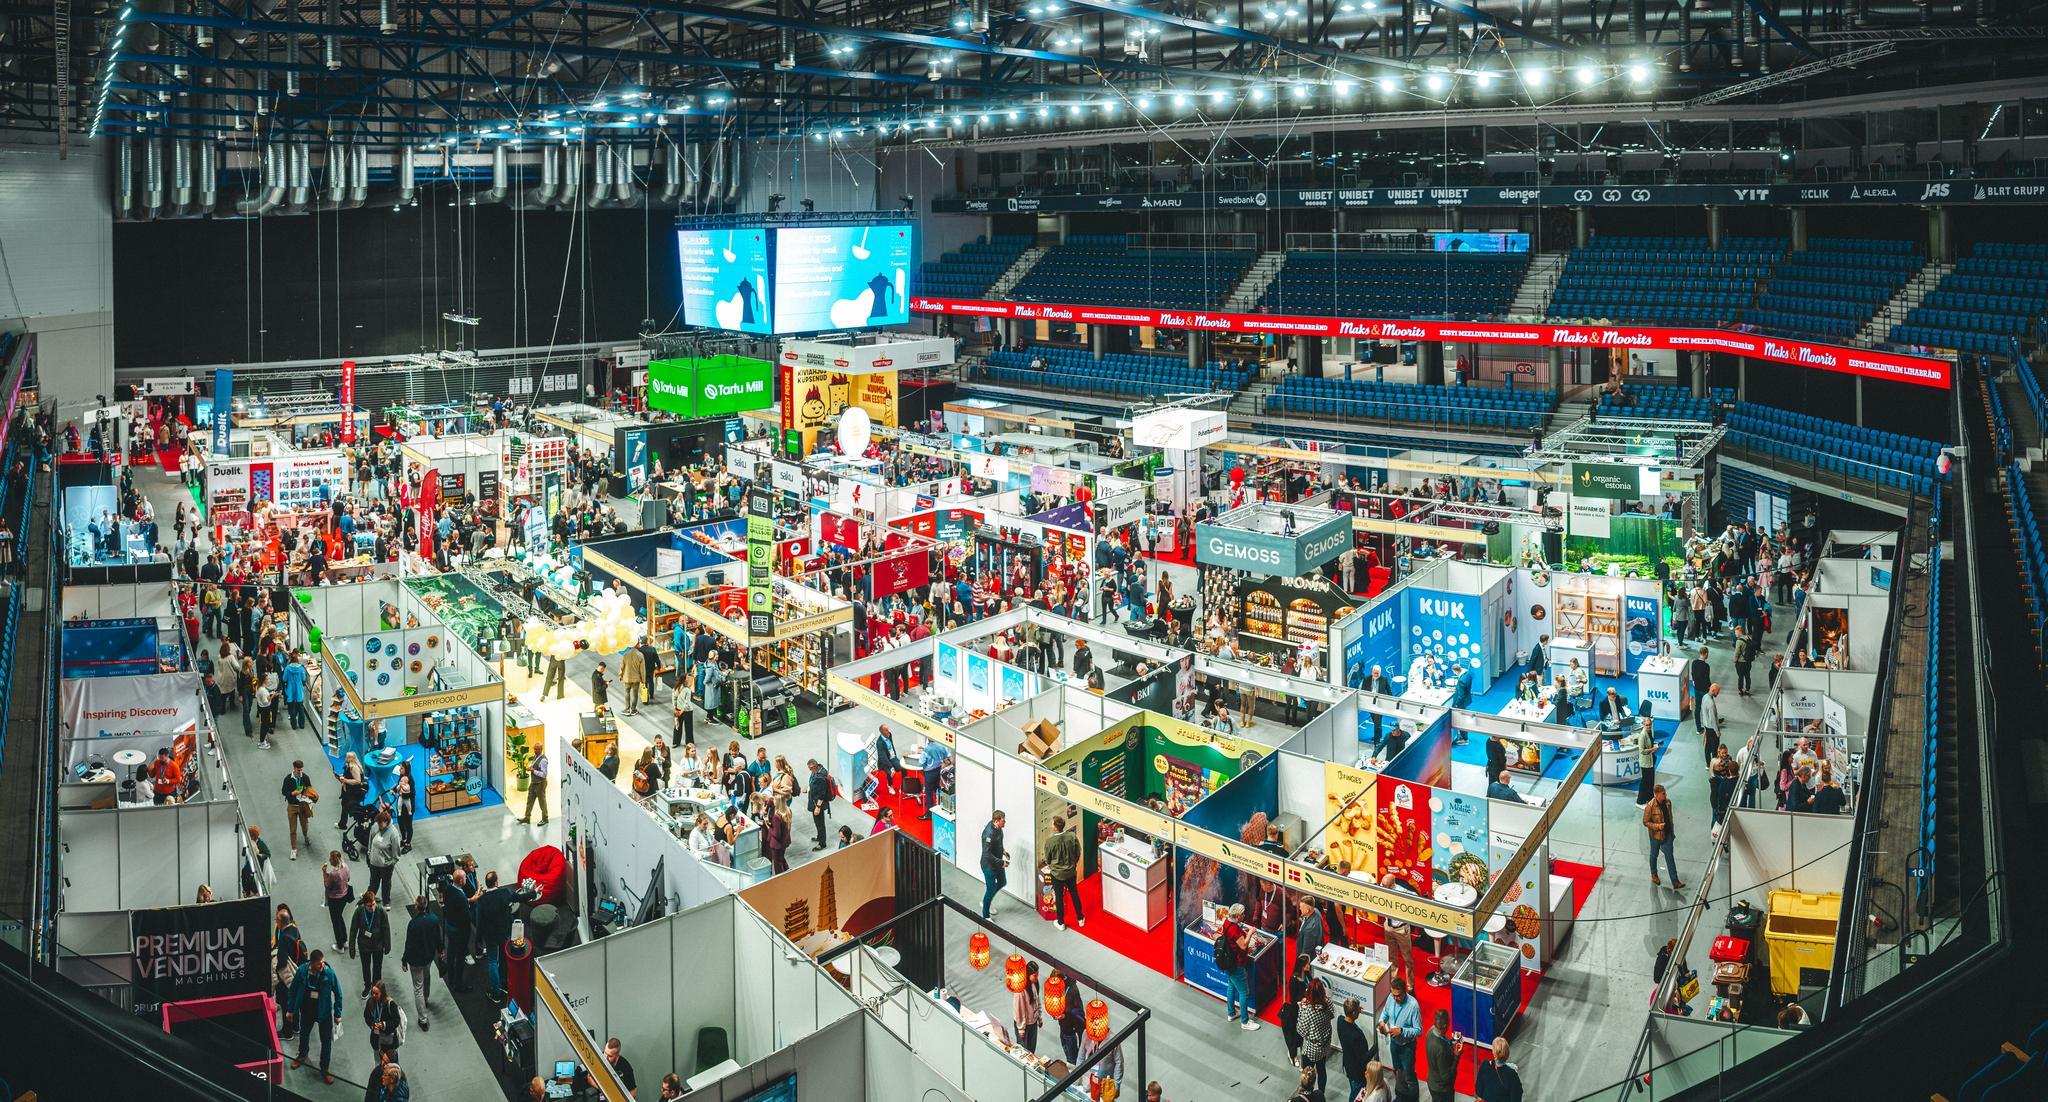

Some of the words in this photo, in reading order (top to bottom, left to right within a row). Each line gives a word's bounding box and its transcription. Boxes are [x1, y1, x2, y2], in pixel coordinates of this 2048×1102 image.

[1299, 191, 1333, 200] UNIBET
[1339, 190, 1374, 199] UNIBET
[1388, 190, 1424, 199] UNIBET
[1431, 189, 1468, 198] UNIBET
[1500, 190, 1540, 204] elenger
[1734, 189, 1769, 200] YIT
[1863, 189, 1897, 197] ALEXELA
[1920, 183, 1950, 200] JAS
[1987, 187, 2011, 196] BLRT
[2013, 186, 2046, 195] GRUPP
[970, 201, 988, 209] weber
[1153, 199, 1182, 207] MARU
[1219, 196, 1255, 204] Swedbank
[920, 300, 943, 311] Moorits
[1015, 305, 1035, 316] Maks
[1036, 308, 1041, 316] &
[1043, 307, 1073, 319] Moorits
[1160, 314, 1185, 326] Maks
[1186, 316, 1193, 326] &
[1194, 316, 1231, 329] Moorits
[1340, 322, 1369, 335] Maks
[1371, 325, 1380, 335] &
[1382, 323, 1425, 338] Moorits
[1553, 329, 1588, 344] Maks
[1589, 332, 1600, 343] &
[1601, 330, 1652, 345] Moorits
[1764, 341, 1789, 359] Maks
[1790, 347, 1797, 360] &
[1799, 346, 1836, 367] Moorits
[660, 380, 675, 396] Tartu
[676, 385, 688, 398] Mill
[717, 384, 745, 396] Tartu
[746, 380, 764, 393] Mill
[1593, 475, 1621, 484] organic
[1605, 482, 1632, 490] estonia
[1210, 537, 1280, 565] GEMOSS
[1304, 532, 1345, 561] GEMOSS
[1281, 574, 1330, 593] MONIN
[1137, 686, 1150, 701] BKI
[414, 697, 456, 708] BERRYFOOD
[456, 694, 468, 702] OÜ
[83, 708, 127, 720] Inspiring
[130, 706, 179, 718] Discovery
[565, 752, 592, 787] ID-BALTI
[1171, 765, 1188, 776] Fruit
[1616, 763, 1641, 778] LAB
[1169, 771, 1192, 783] snacks
[466, 781, 482, 792] UUS
[1095, 797, 1121, 815] MYBITE
[1503, 839, 1520, 847] DENCON
[1912, 868, 1925, 878] 10
[1314, 881, 1333, 892] DENCON
[1333, 887, 1350, 897] FOODS
[1353, 889, 1394, 911] DENCON
[1394, 899, 1428, 919] FOODS
[1429, 910, 1449, 925] A/S
[136, 925, 245, 957] PREMIUM
[1187, 946, 1210, 962] QUALITY
[136, 947, 244, 979] VENDING
[175, 970, 246, 986] MACHINES
